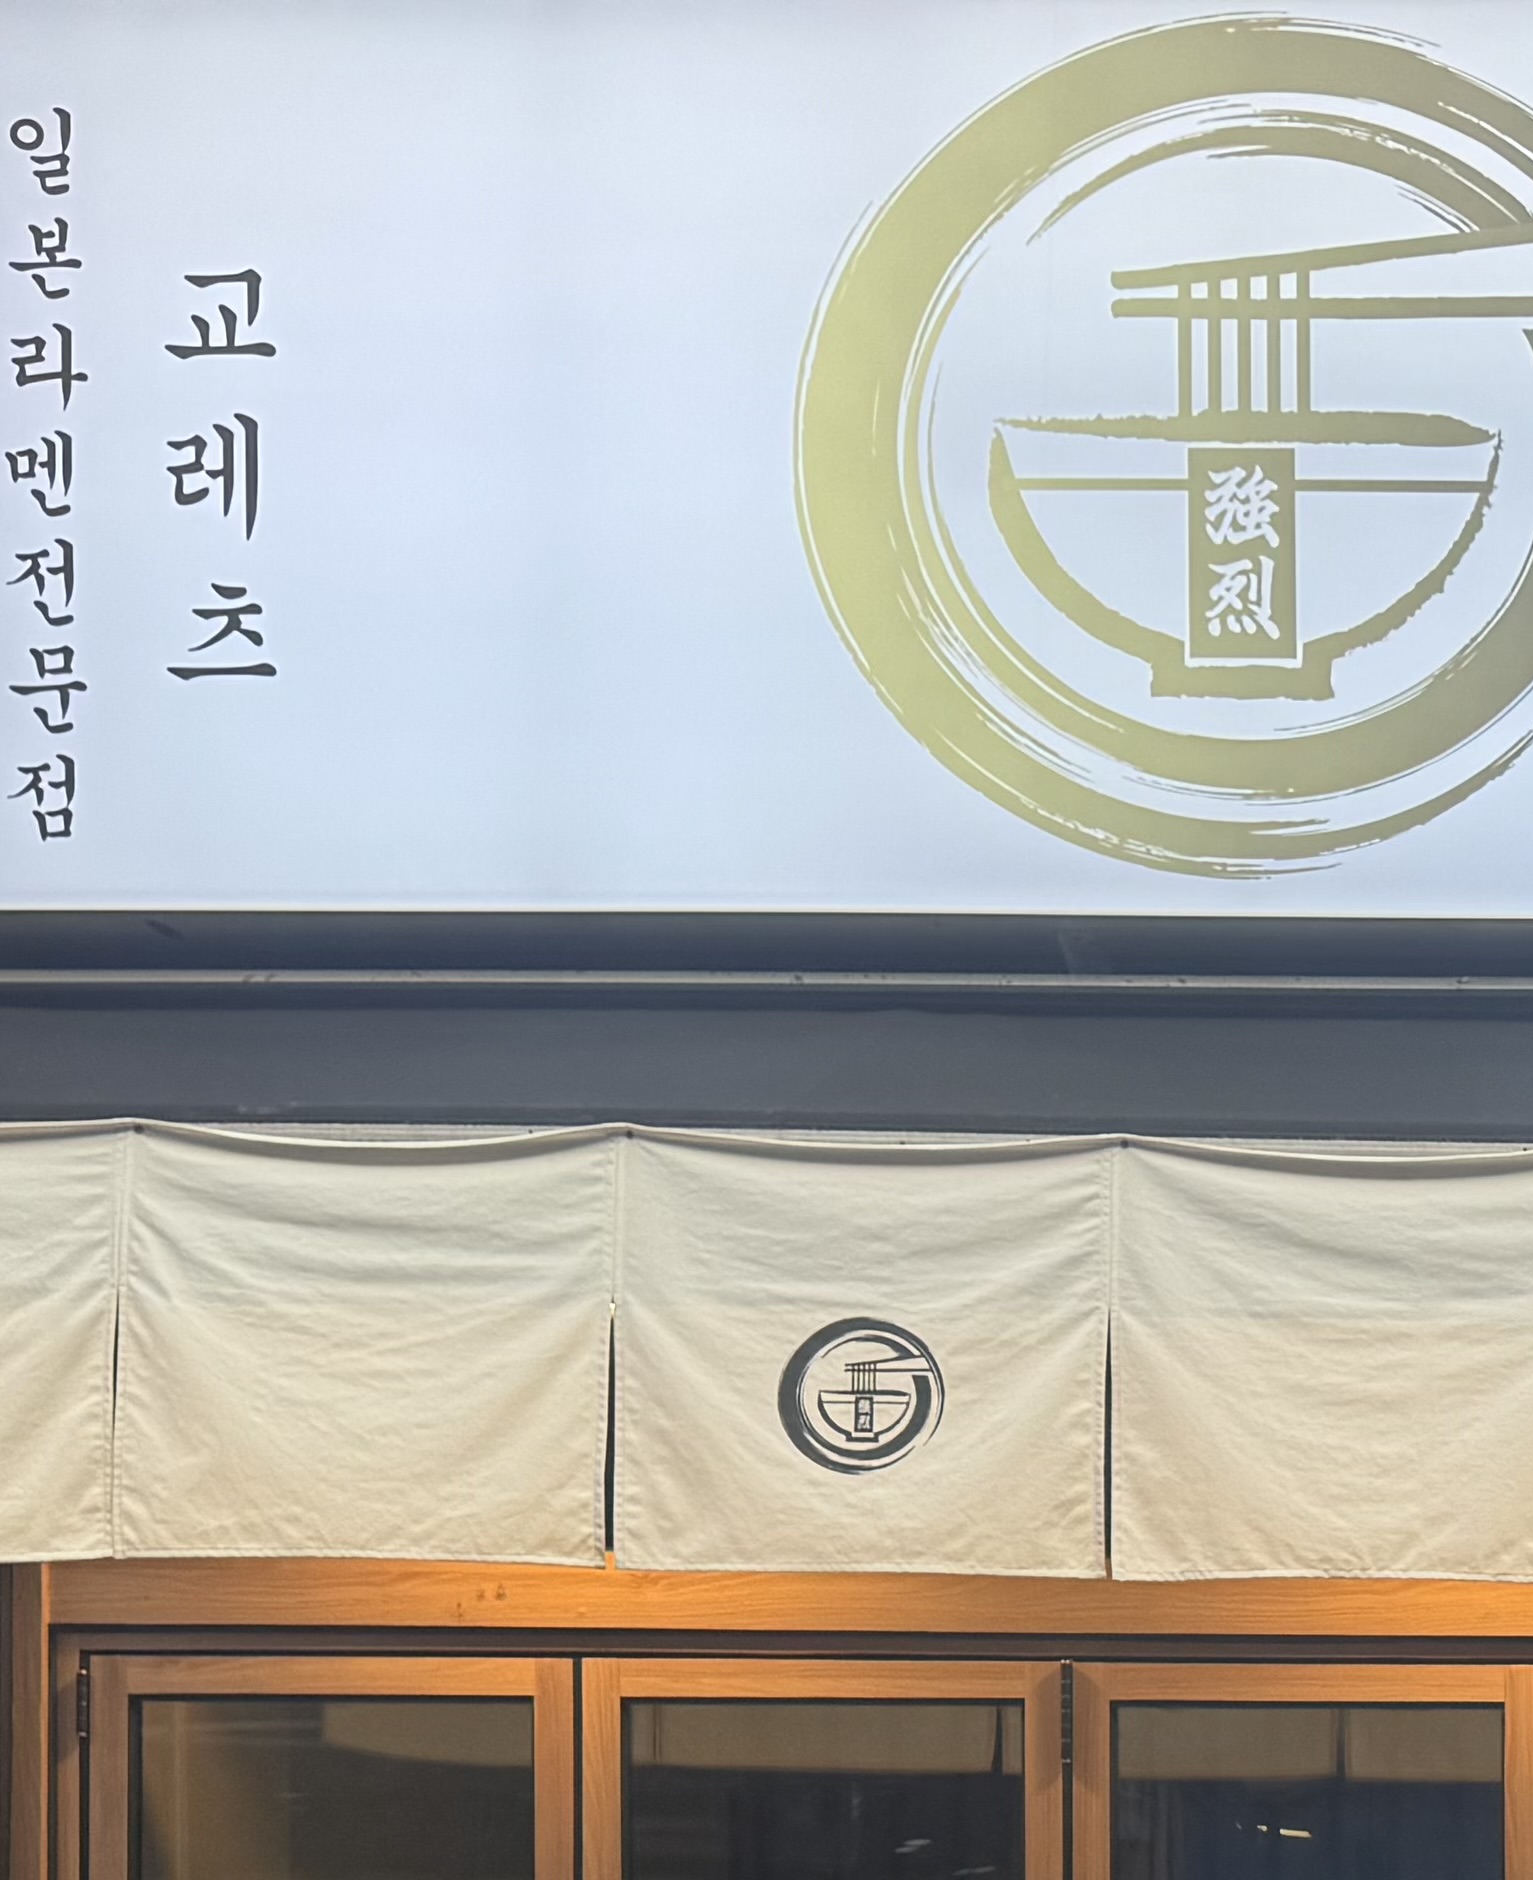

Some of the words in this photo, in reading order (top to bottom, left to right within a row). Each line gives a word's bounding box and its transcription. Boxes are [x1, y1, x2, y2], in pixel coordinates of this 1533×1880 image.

[5, 107, 88, 842] 일본라멘전문점
[164, 269, 277, 681] 교레츠
[1203, 463, 1281, 640] 強烈
